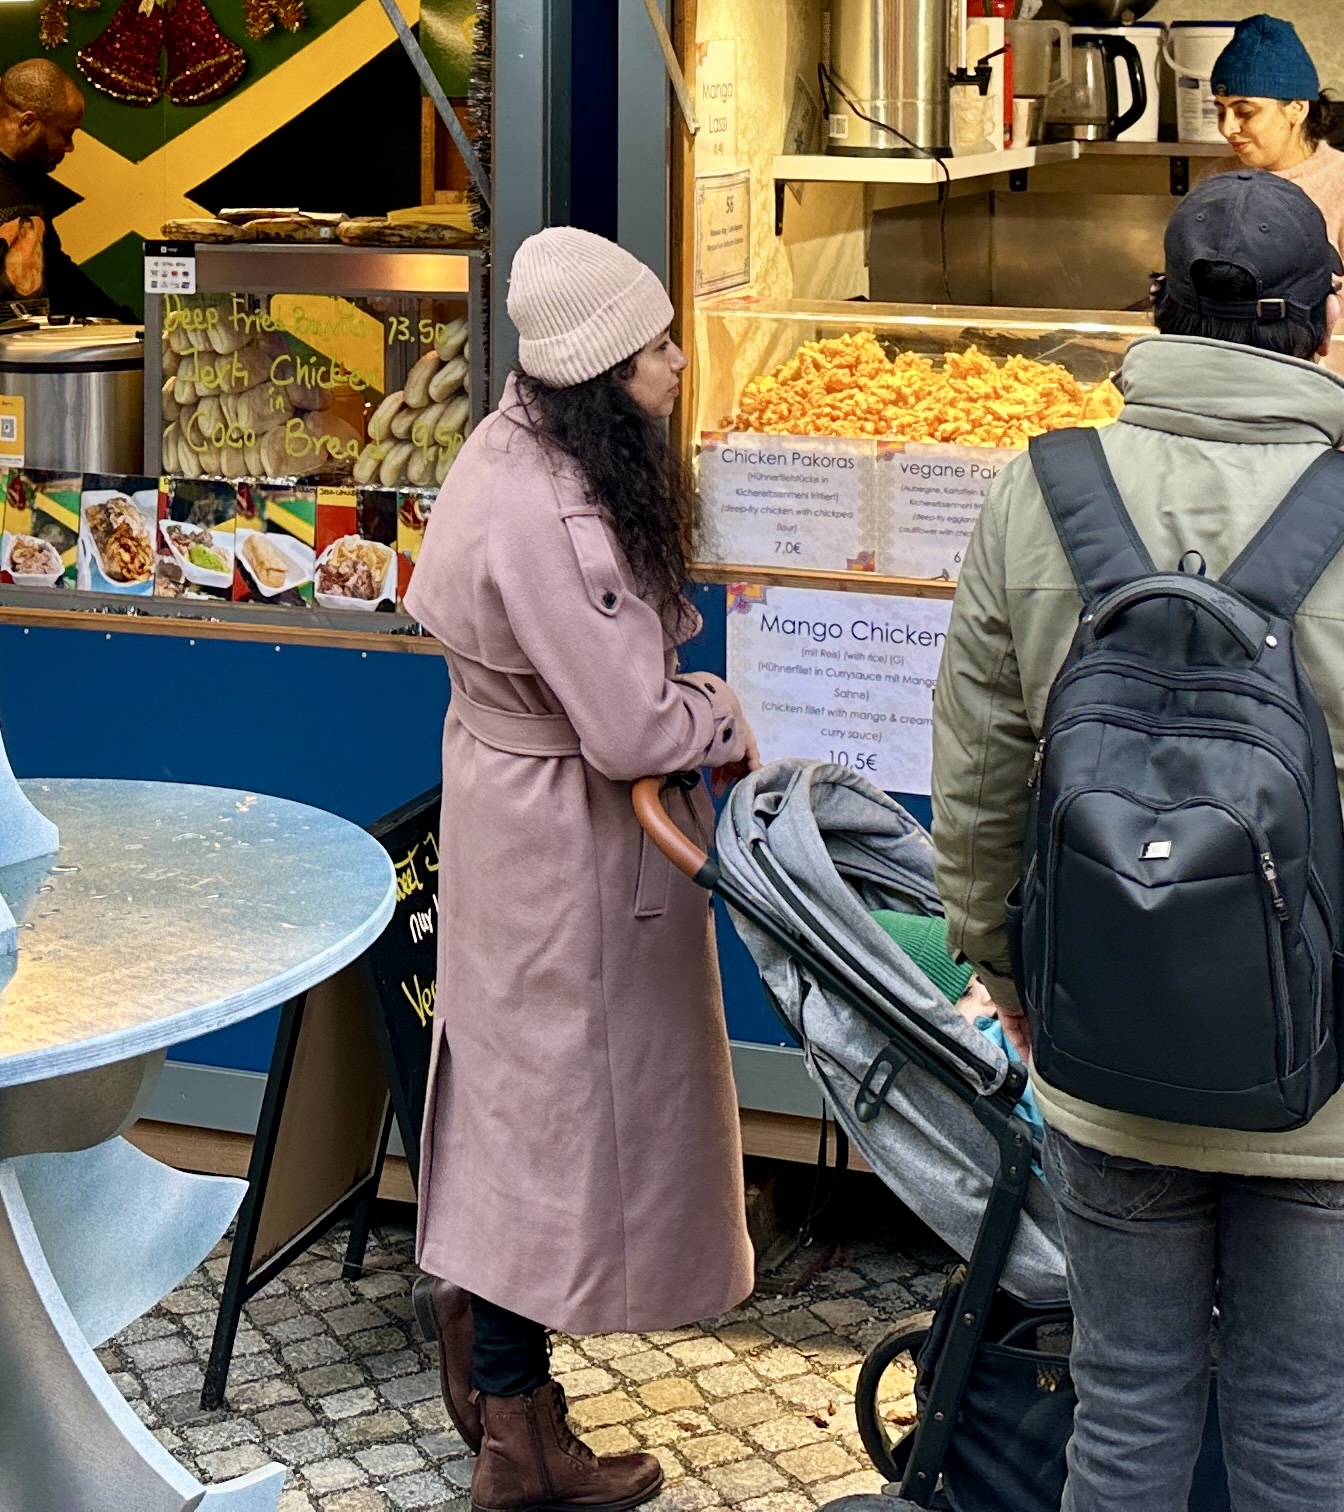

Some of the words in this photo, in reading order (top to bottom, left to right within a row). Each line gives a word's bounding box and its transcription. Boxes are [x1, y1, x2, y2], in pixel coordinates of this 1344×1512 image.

[163, 293, 218, 333] Deep
[229, 293, 284, 334] Fried
[387, 316, 448, 345] 13.50
[180, 348, 248, 388] Jerk
[270, 355, 379, 390] Chicken
[269, 387, 285, 413] in
[187, 410, 256, 452] Coco
[285, 415, 387, 460] Bread
[721, 448, 787, 466] Chicken
[792, 452, 855, 469] Pakoras
[900, 463, 965, 479] vegane
[971, 464, 1000, 480] Pak
[796, 507, 813, 516] with
[774, 541, 802, 555] 7,0€
[760, 613, 843, 642] Mango
[851, 620, 947, 648] Chicken
[802, 648, 818, 658] (mit
[814, 666, 823, 676] in
[826, 667, 882, 682] Currysauce
[884, 673, 900, 683] mit
[834, 688, 869, 702] Sahne)
[762, 701, 803, 714] (chicken
[827, 708, 847, 718] with
[850, 711, 887, 723] mango
[889, 713, 897, 723] &
[821, 728, 846, 740] curry
[847, 729, 883, 744] sauce)
